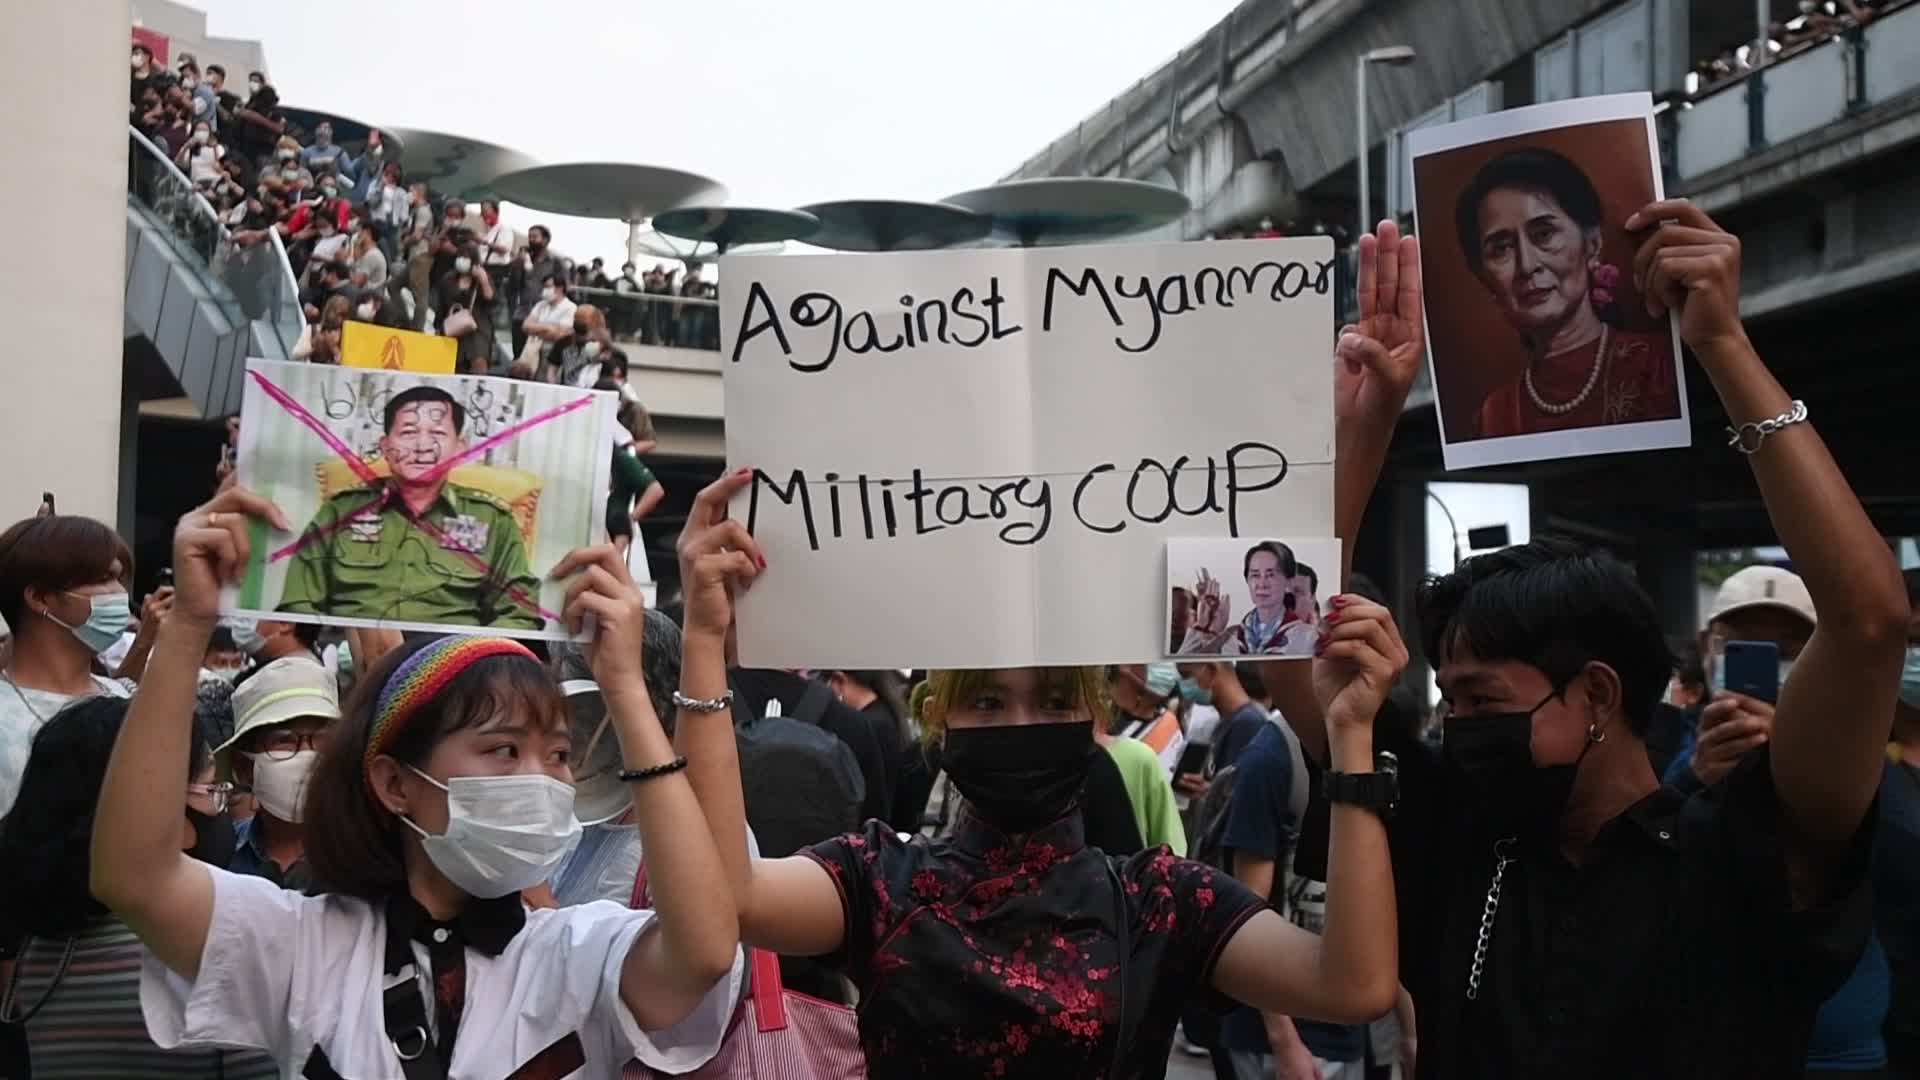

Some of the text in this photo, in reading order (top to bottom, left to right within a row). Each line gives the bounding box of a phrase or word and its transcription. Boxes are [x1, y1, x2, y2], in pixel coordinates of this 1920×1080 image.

[731, 259, 1335, 373] Against Myanmar
[746, 468, 1052, 552] Military
